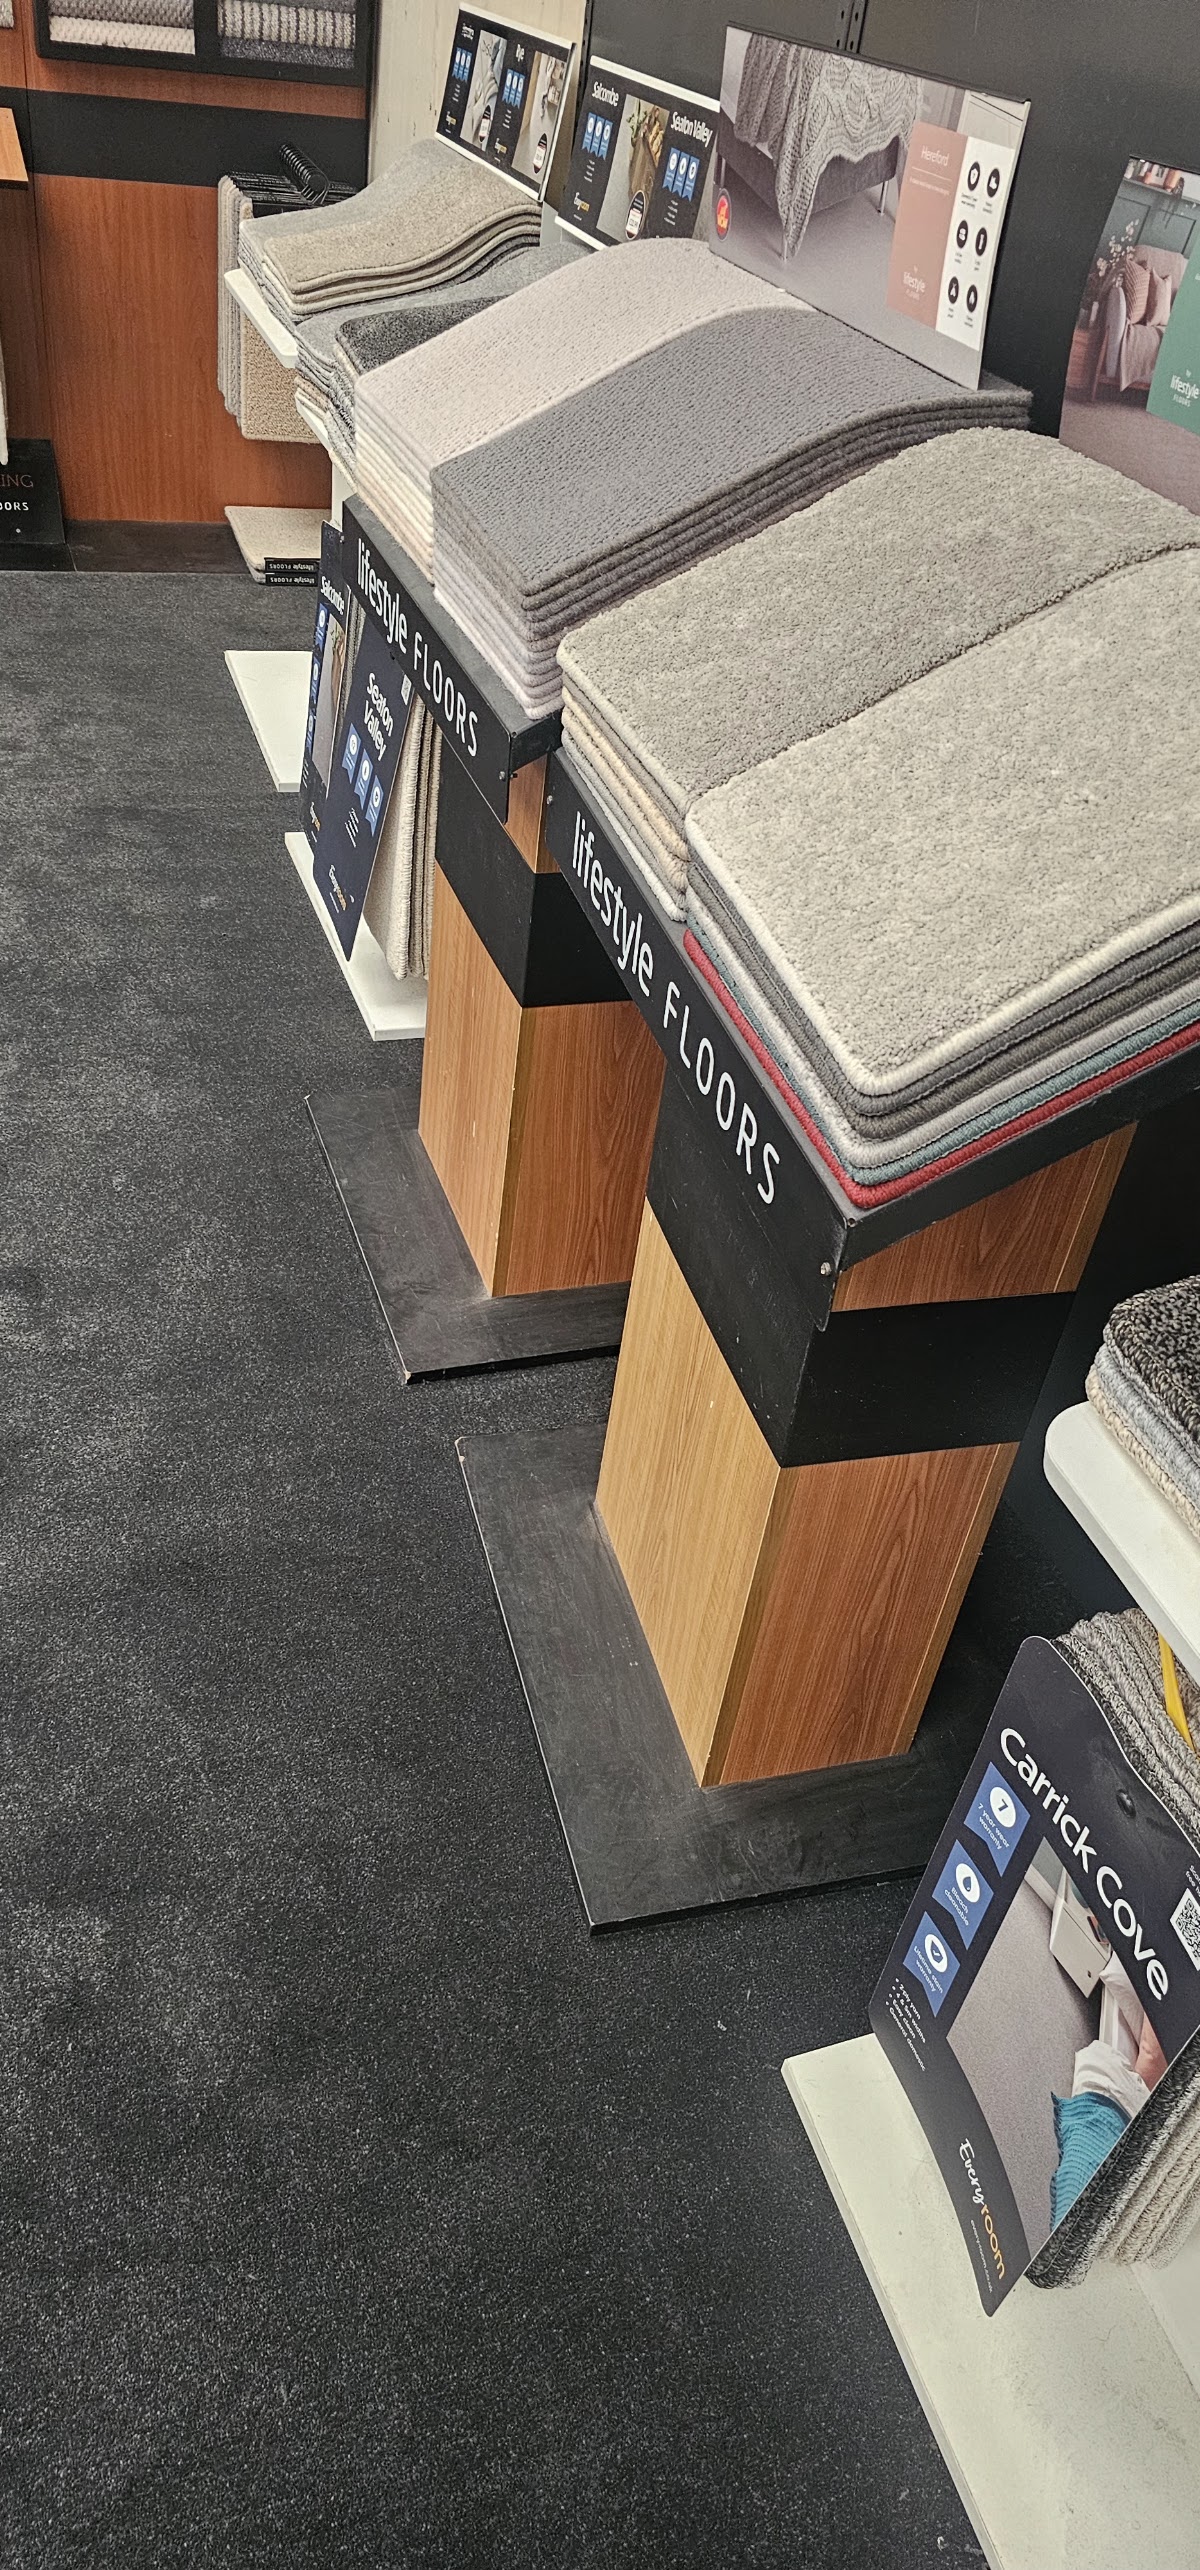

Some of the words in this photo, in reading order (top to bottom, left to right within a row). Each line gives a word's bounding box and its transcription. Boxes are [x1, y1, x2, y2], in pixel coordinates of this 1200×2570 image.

[592, 81, 619, 107] Salcombe
[670, 111, 694, 138] Seaton
[692, 120, 713, 147] Valley
[921, 145, 949, 166] Hereford
[1170, 374, 1200, 399] lifestyle
[293, 563, 314, 571] lifestyle
[293, 576, 315, 584] lifestyle
[320, 576, 345, 615] Salcombe
[357, 538, 408, 654] lifestyle
[413, 631, 478, 757] FLOORS
[366, 672, 394, 737] Seaton
[363, 701, 387, 761] Valley
[573, 811, 653, 997] lifestyle
[663, 981, 780, 1204] FLOORS
[998, 1798, 1009, 1812] 7
[979, 1816, 1002, 1850] warranty
[982, 1810, 996, 1827] year
[995, 1827, 1010, 1848] wear
[1000, 1727, 1098, 1873] Carrick
[1096, 1865, 1169, 2000] Cove
[945, 1889, 969, 1926] cleanable
[951, 1887, 968, 1913] Bleach
[914, 1945, 932, 1974] Lifetime
[931, 1974, 943, 1994] stain
[916, 1959, 937, 1992] warranty
[893, 1999, 904, 2017] Easy
[903, 2017, 916, 2039] clean
[910, 2002, 921, 2020] yarn
[889, 2007, 908, 2037] General
[906, 2037, 926, 2071] domestic
[911, 2018, 926, 2043] widths
